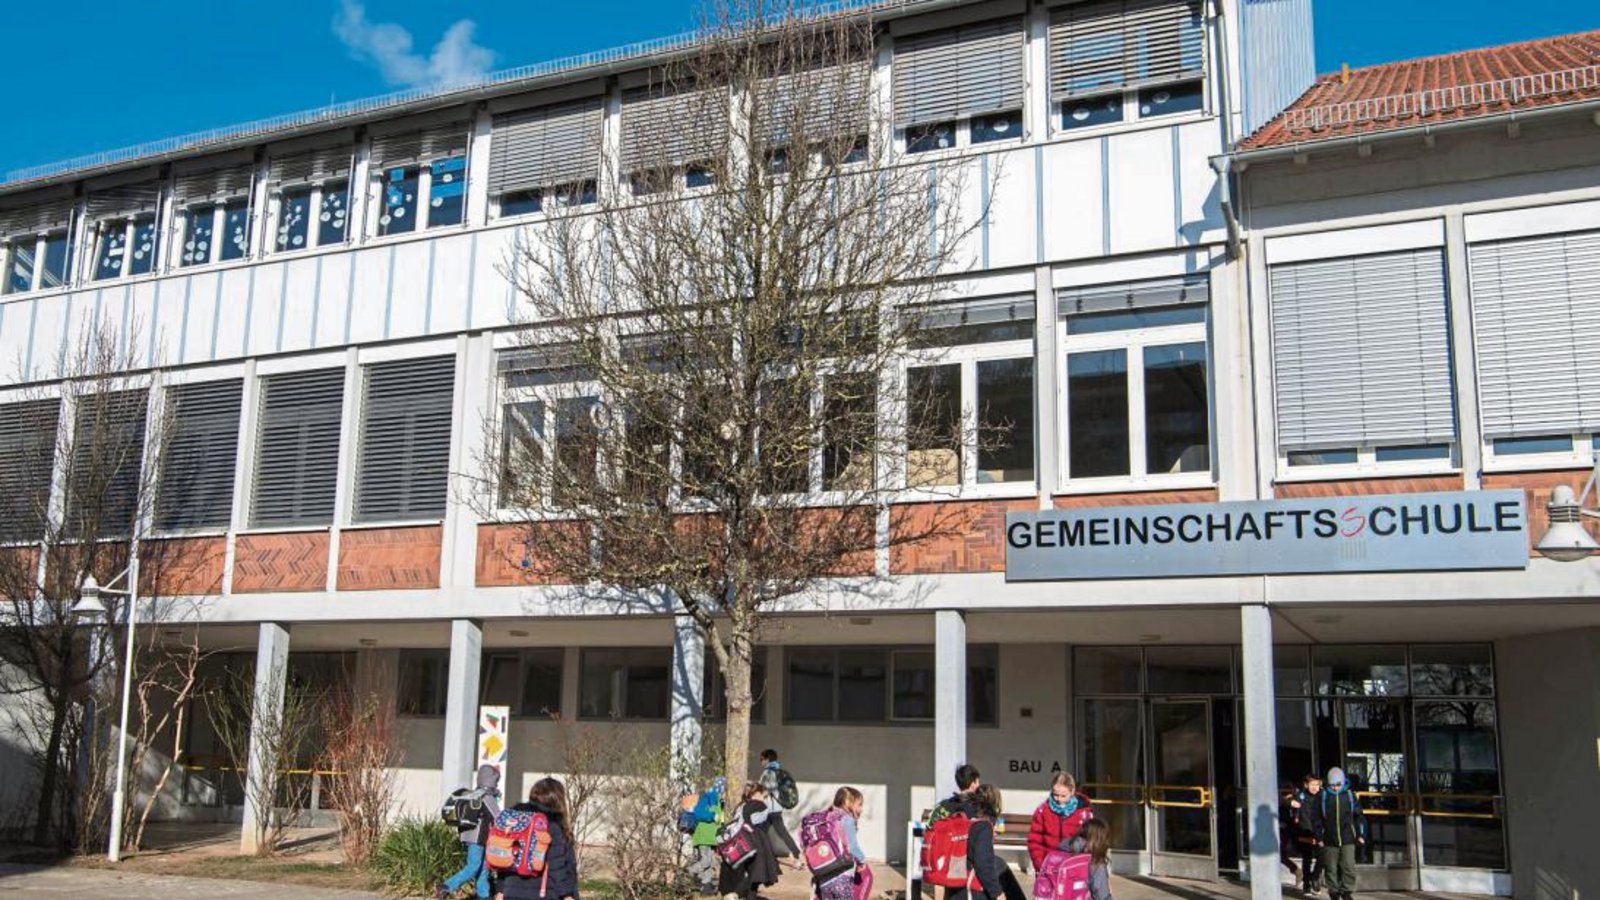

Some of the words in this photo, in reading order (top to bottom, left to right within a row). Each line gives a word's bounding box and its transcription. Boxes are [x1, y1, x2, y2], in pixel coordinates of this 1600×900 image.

[1007, 501, 1522, 549] GEMEINSCHAFTSSCHULE
[1009, 760, 1041, 773] BAU
[1051, 761, 1062, 773] A
